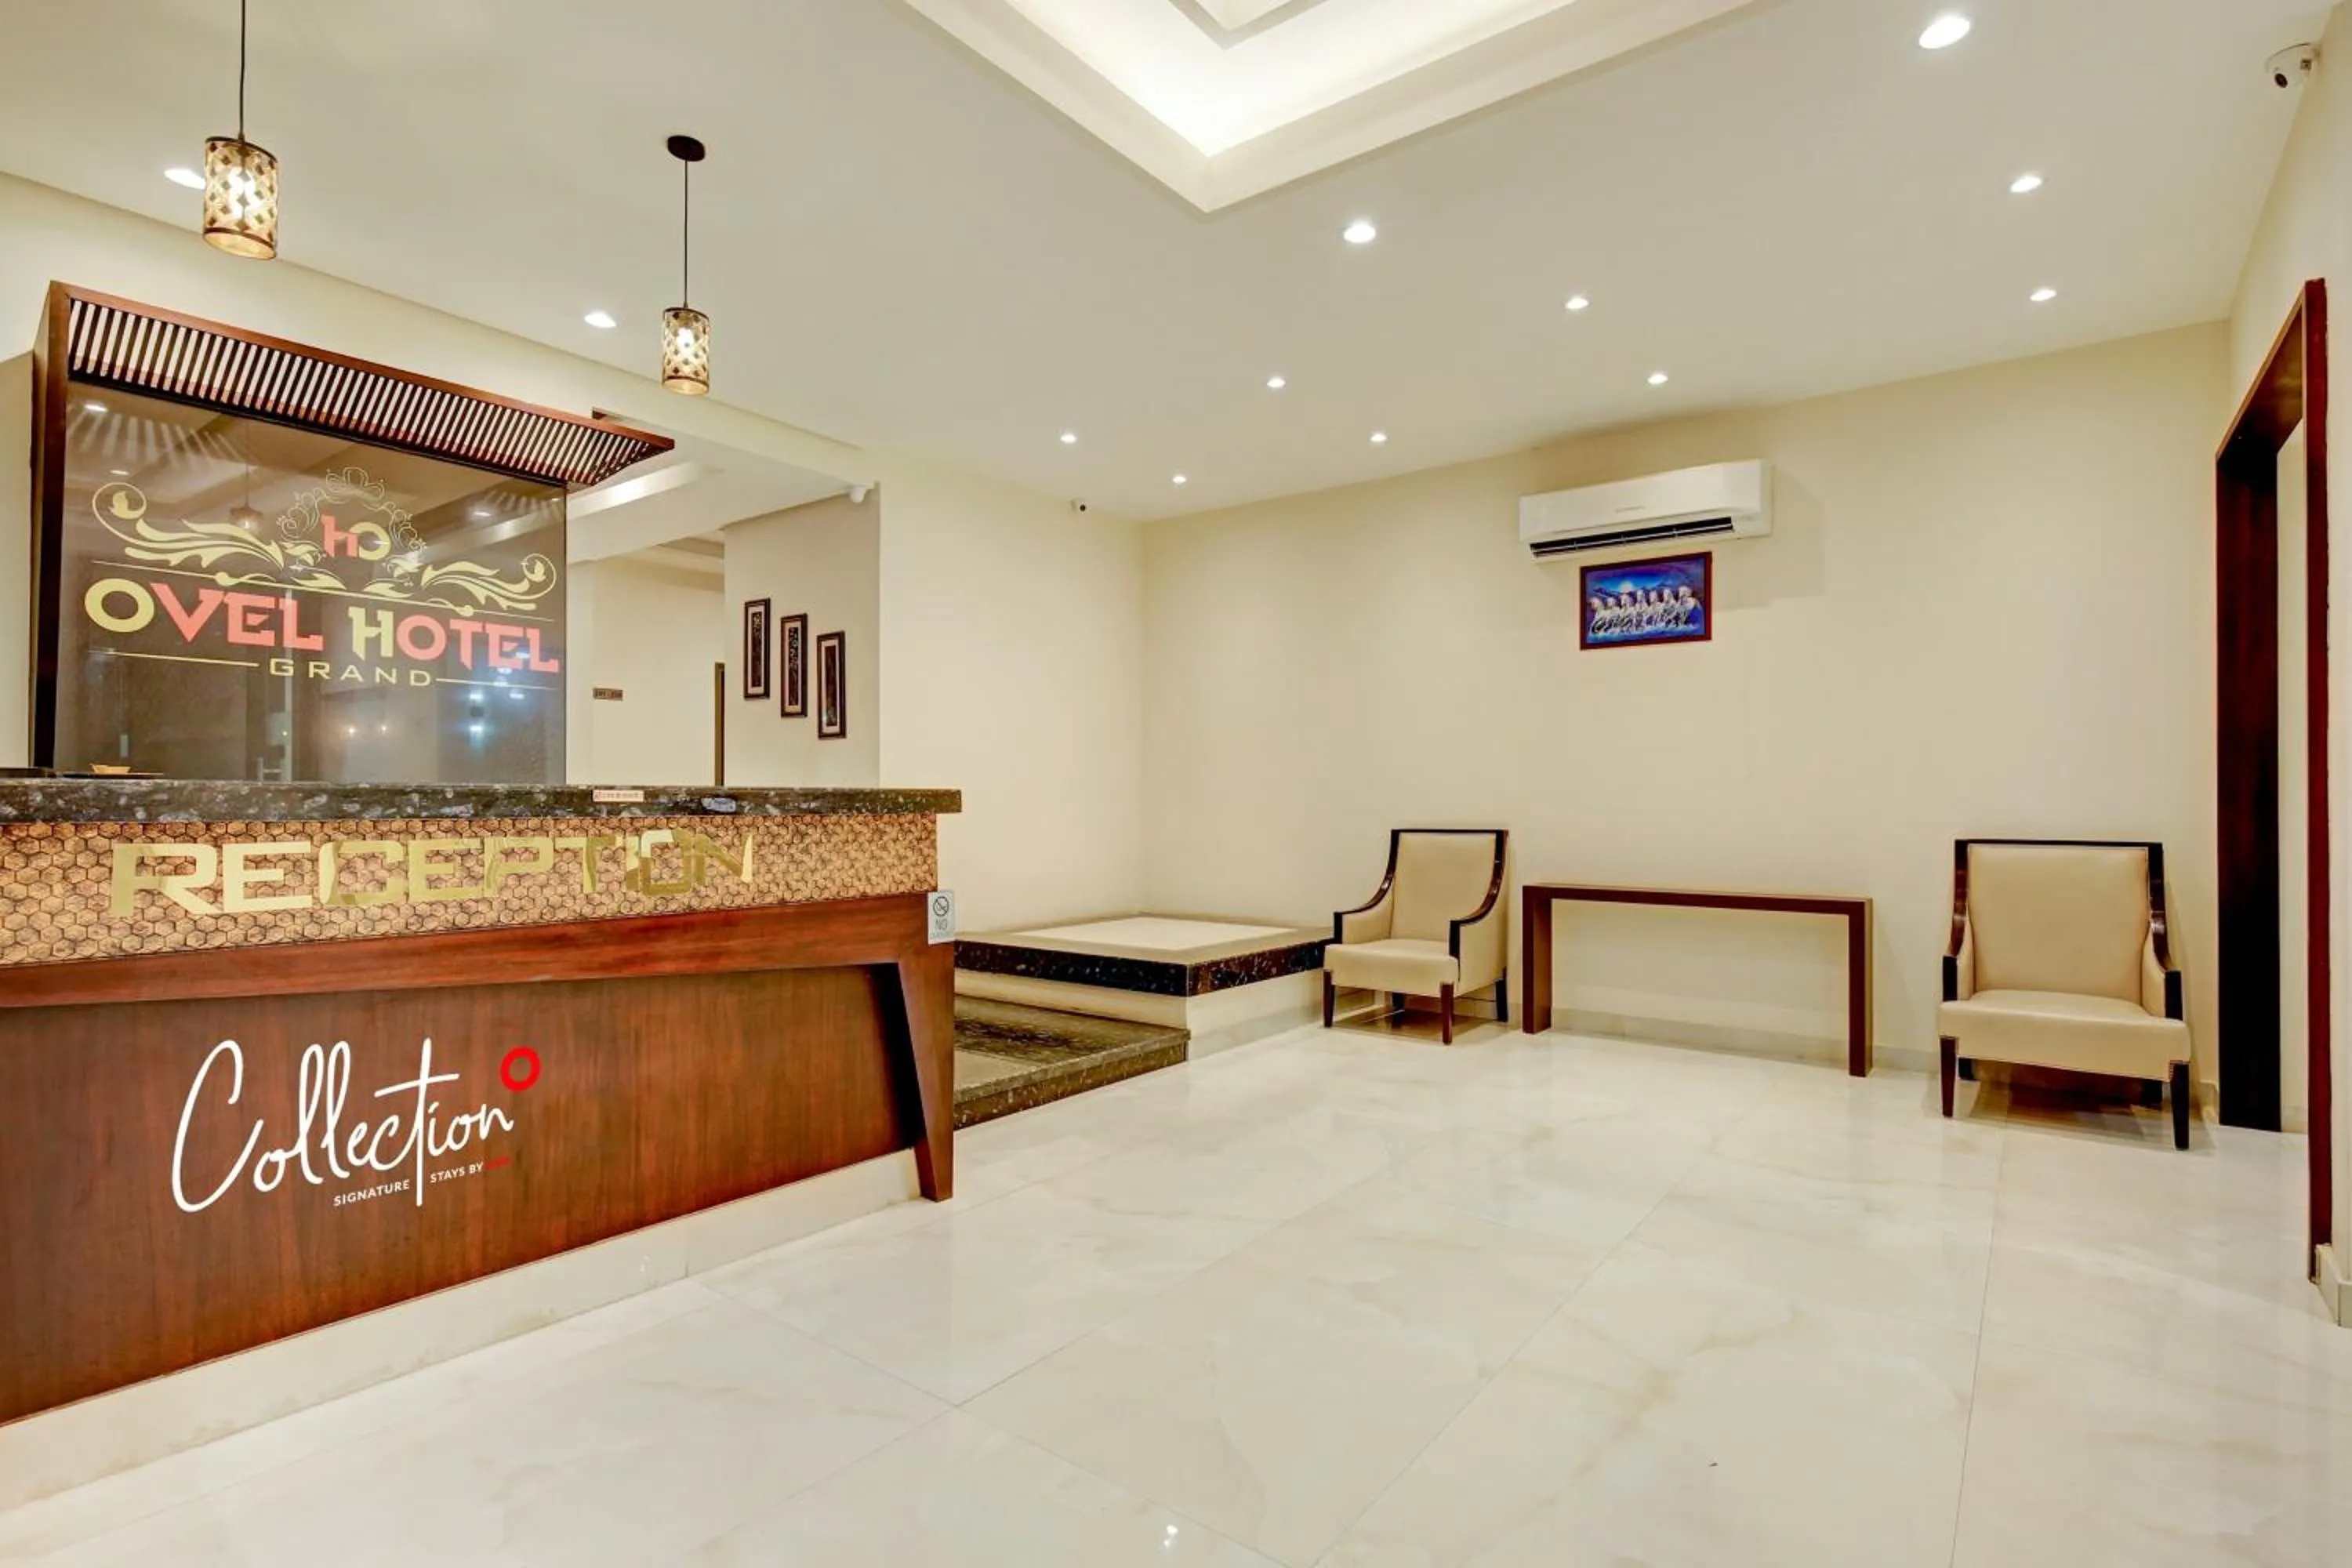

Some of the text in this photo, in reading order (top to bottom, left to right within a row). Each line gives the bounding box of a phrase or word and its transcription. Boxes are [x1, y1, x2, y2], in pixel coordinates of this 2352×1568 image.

[84, 577, 560, 673] OVEL HOTEL
[270, 657, 431, 687] GRAND
[108, 829, 753, 917] RECEPTION
[172, 1037, 514, 1213] Collection
[332, 1178, 411, 1207] SIGNATURE
[430, 1167, 466, 1184] STAYS
[469, 1161, 485, 1174] BY
